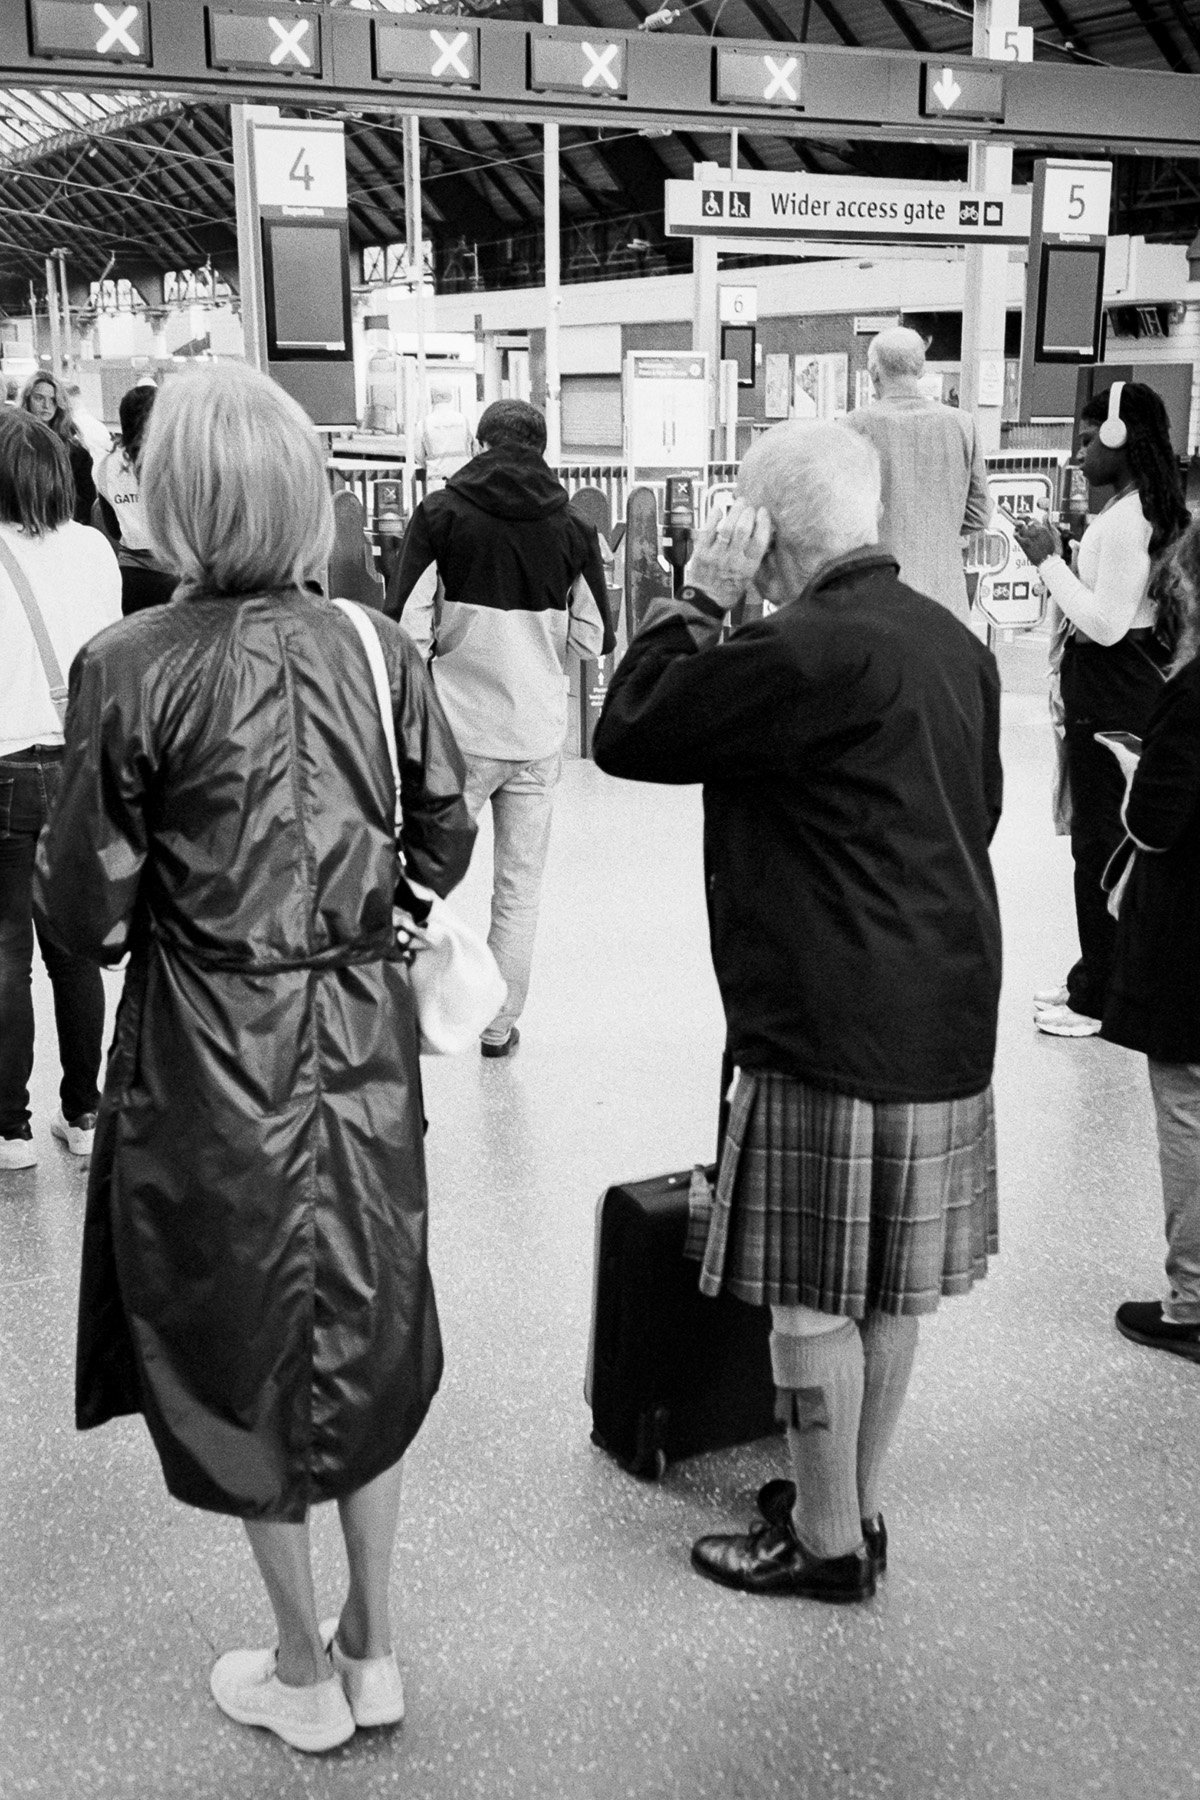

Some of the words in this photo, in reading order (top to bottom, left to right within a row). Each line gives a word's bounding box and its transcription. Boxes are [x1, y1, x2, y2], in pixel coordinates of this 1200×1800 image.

[1004, 31, 1019, 61] 5
[289, 147, 315, 191] 4
[771, 192, 831, 216] Wider
[836, 200, 898, 218] access
[904, 199, 946, 225] gate
[1068, 184, 1085, 219] 5
[734, 294, 743, 313] 6
